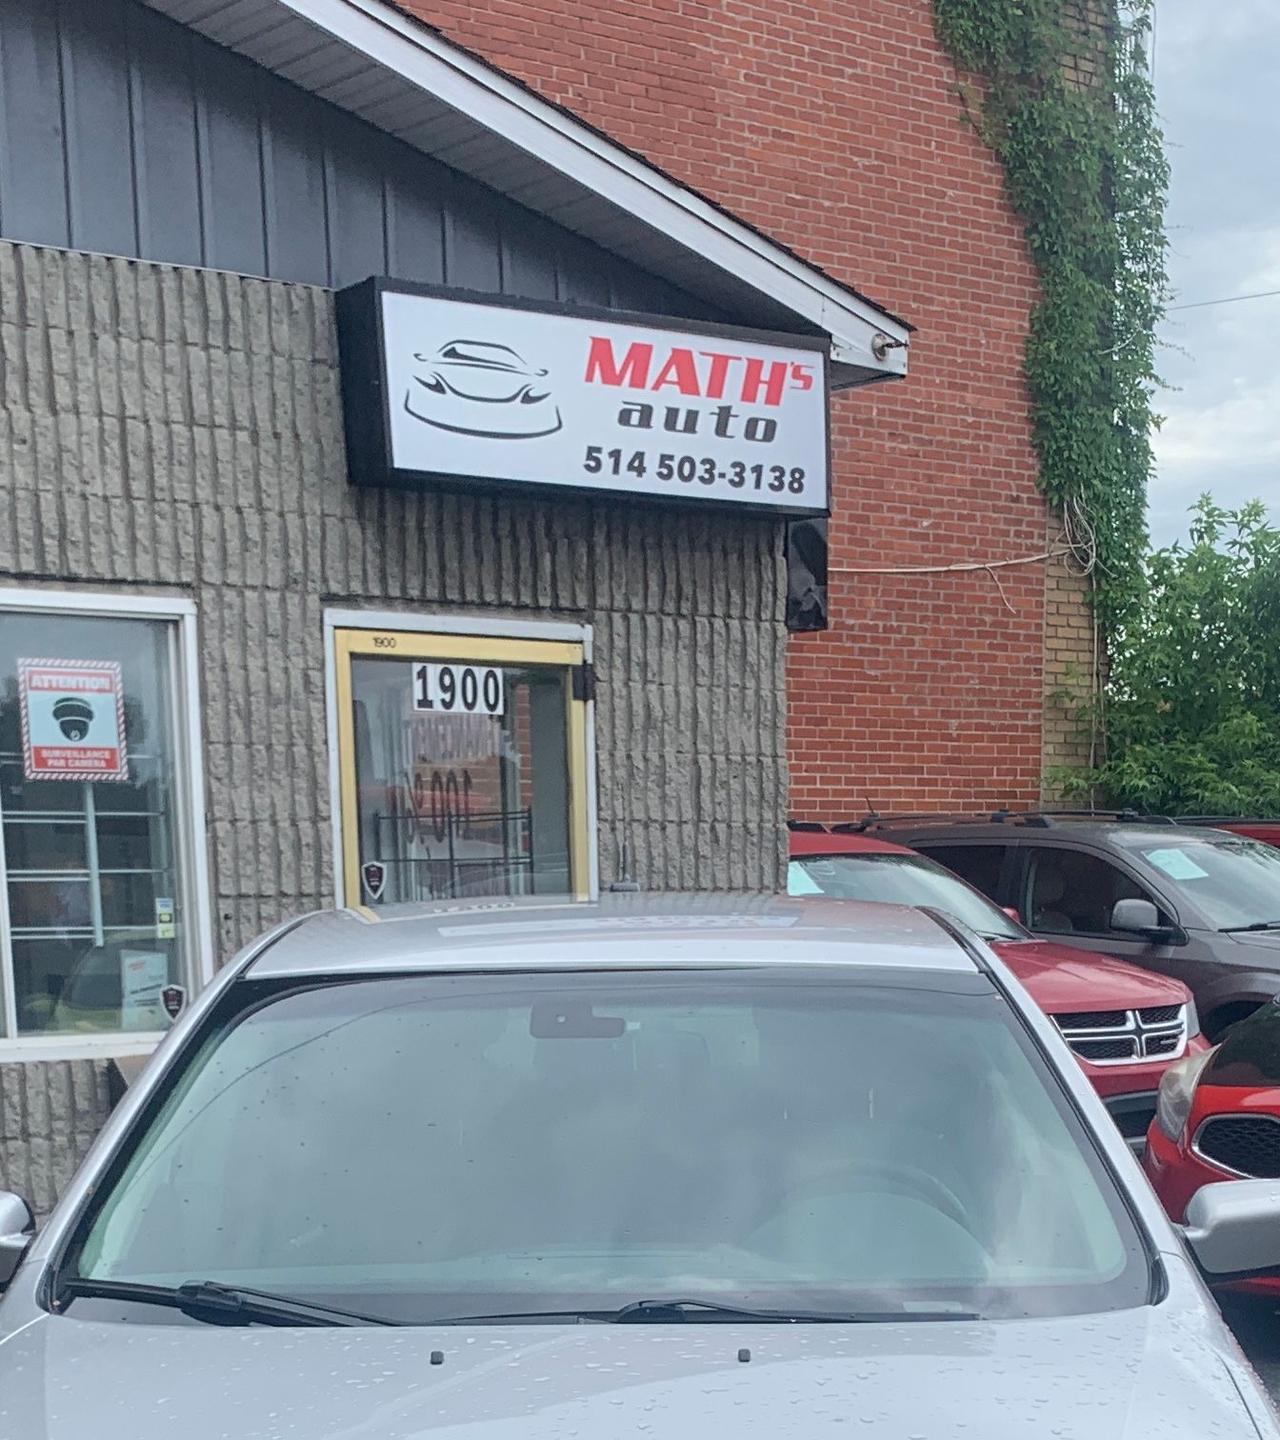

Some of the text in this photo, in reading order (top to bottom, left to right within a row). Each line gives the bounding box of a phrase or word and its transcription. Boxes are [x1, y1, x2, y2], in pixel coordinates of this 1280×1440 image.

[617, 401, 777, 443] auto
[583, 445, 805, 494] 514 503-3138
[373, 636, 397, 648] 1900
[31, 675, 110, 690] ATTENTION
[417, 665, 499, 712] 1900
[41, 748, 111, 759] SURVEILLANCE
[47, 759, 66, 767] PAR
